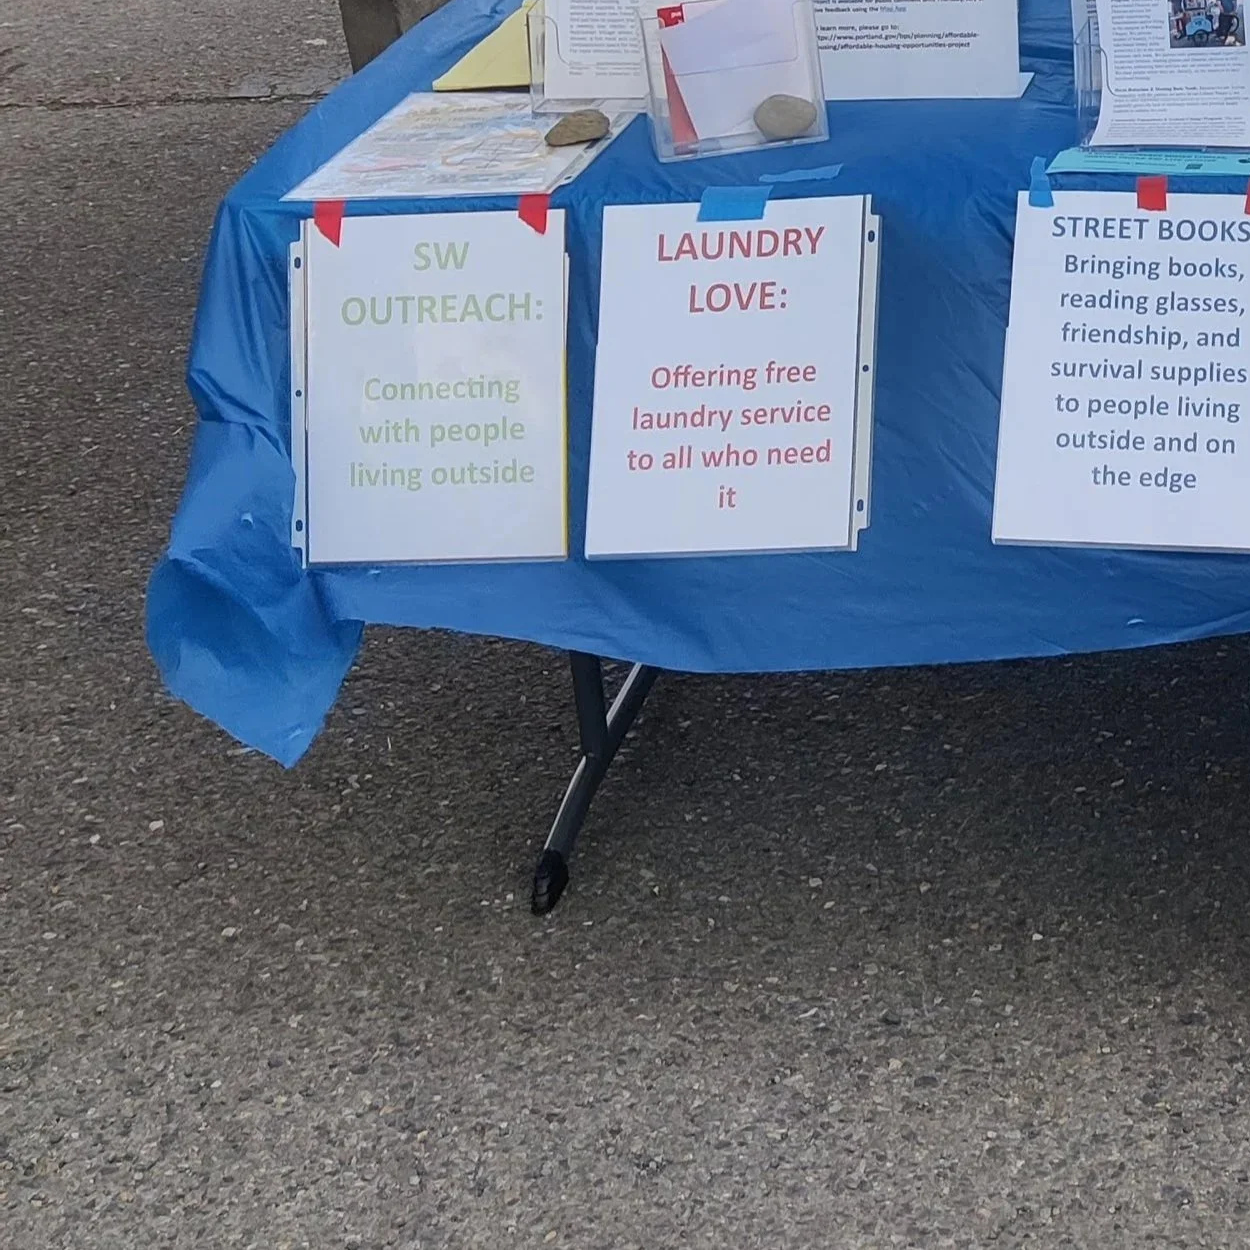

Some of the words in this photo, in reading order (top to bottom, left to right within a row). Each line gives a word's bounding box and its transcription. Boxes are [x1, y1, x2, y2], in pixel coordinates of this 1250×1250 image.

[1052, 216, 1149, 239] STREET
[413, 242, 470, 271] SW
[658, 226, 824, 262] LAUNDRY
[1065, 254, 1161, 280] Bringing
[1169, 257, 1244, 281] books,
[341, 292, 543, 326] OUTREACH:
[689, 282, 788, 313] LOVE:
[1060, 289, 1148, 315] reading
[1155, 292, 1245, 317] glasses,
[1062, 322, 1188, 350] friendship,
[1196, 328, 1240, 347] and
[651, 364, 756, 390] Offering
[766, 361, 816, 384] free
[1051, 359, 1142, 380] survival
[1151, 363, 1248, 386] supplies
[364, 375, 520, 403] Connecting
[633, 405, 732, 432] laundry
[741, 401, 831, 426] service
[1056, 394, 1079, 413] to
[1088, 395, 1169, 419] people
[1178, 397, 1241, 423] living
[360, 419, 419, 444] with
[430, 417, 525, 447] people
[1056, 430, 1145, 450] outside
[1153, 432, 1198, 453] and
[1206, 436, 1236, 454] on
[628, 449, 653, 471] to
[662, 446, 692, 469] all
[702, 443, 757, 468] who
[767, 439, 831, 466] need
[350, 463, 422, 491] living
[431, 459, 534, 486] outside
[1092, 465, 1131, 486] the
[1139, 467, 1197, 492] edge
[719, 485, 736, 508] it
